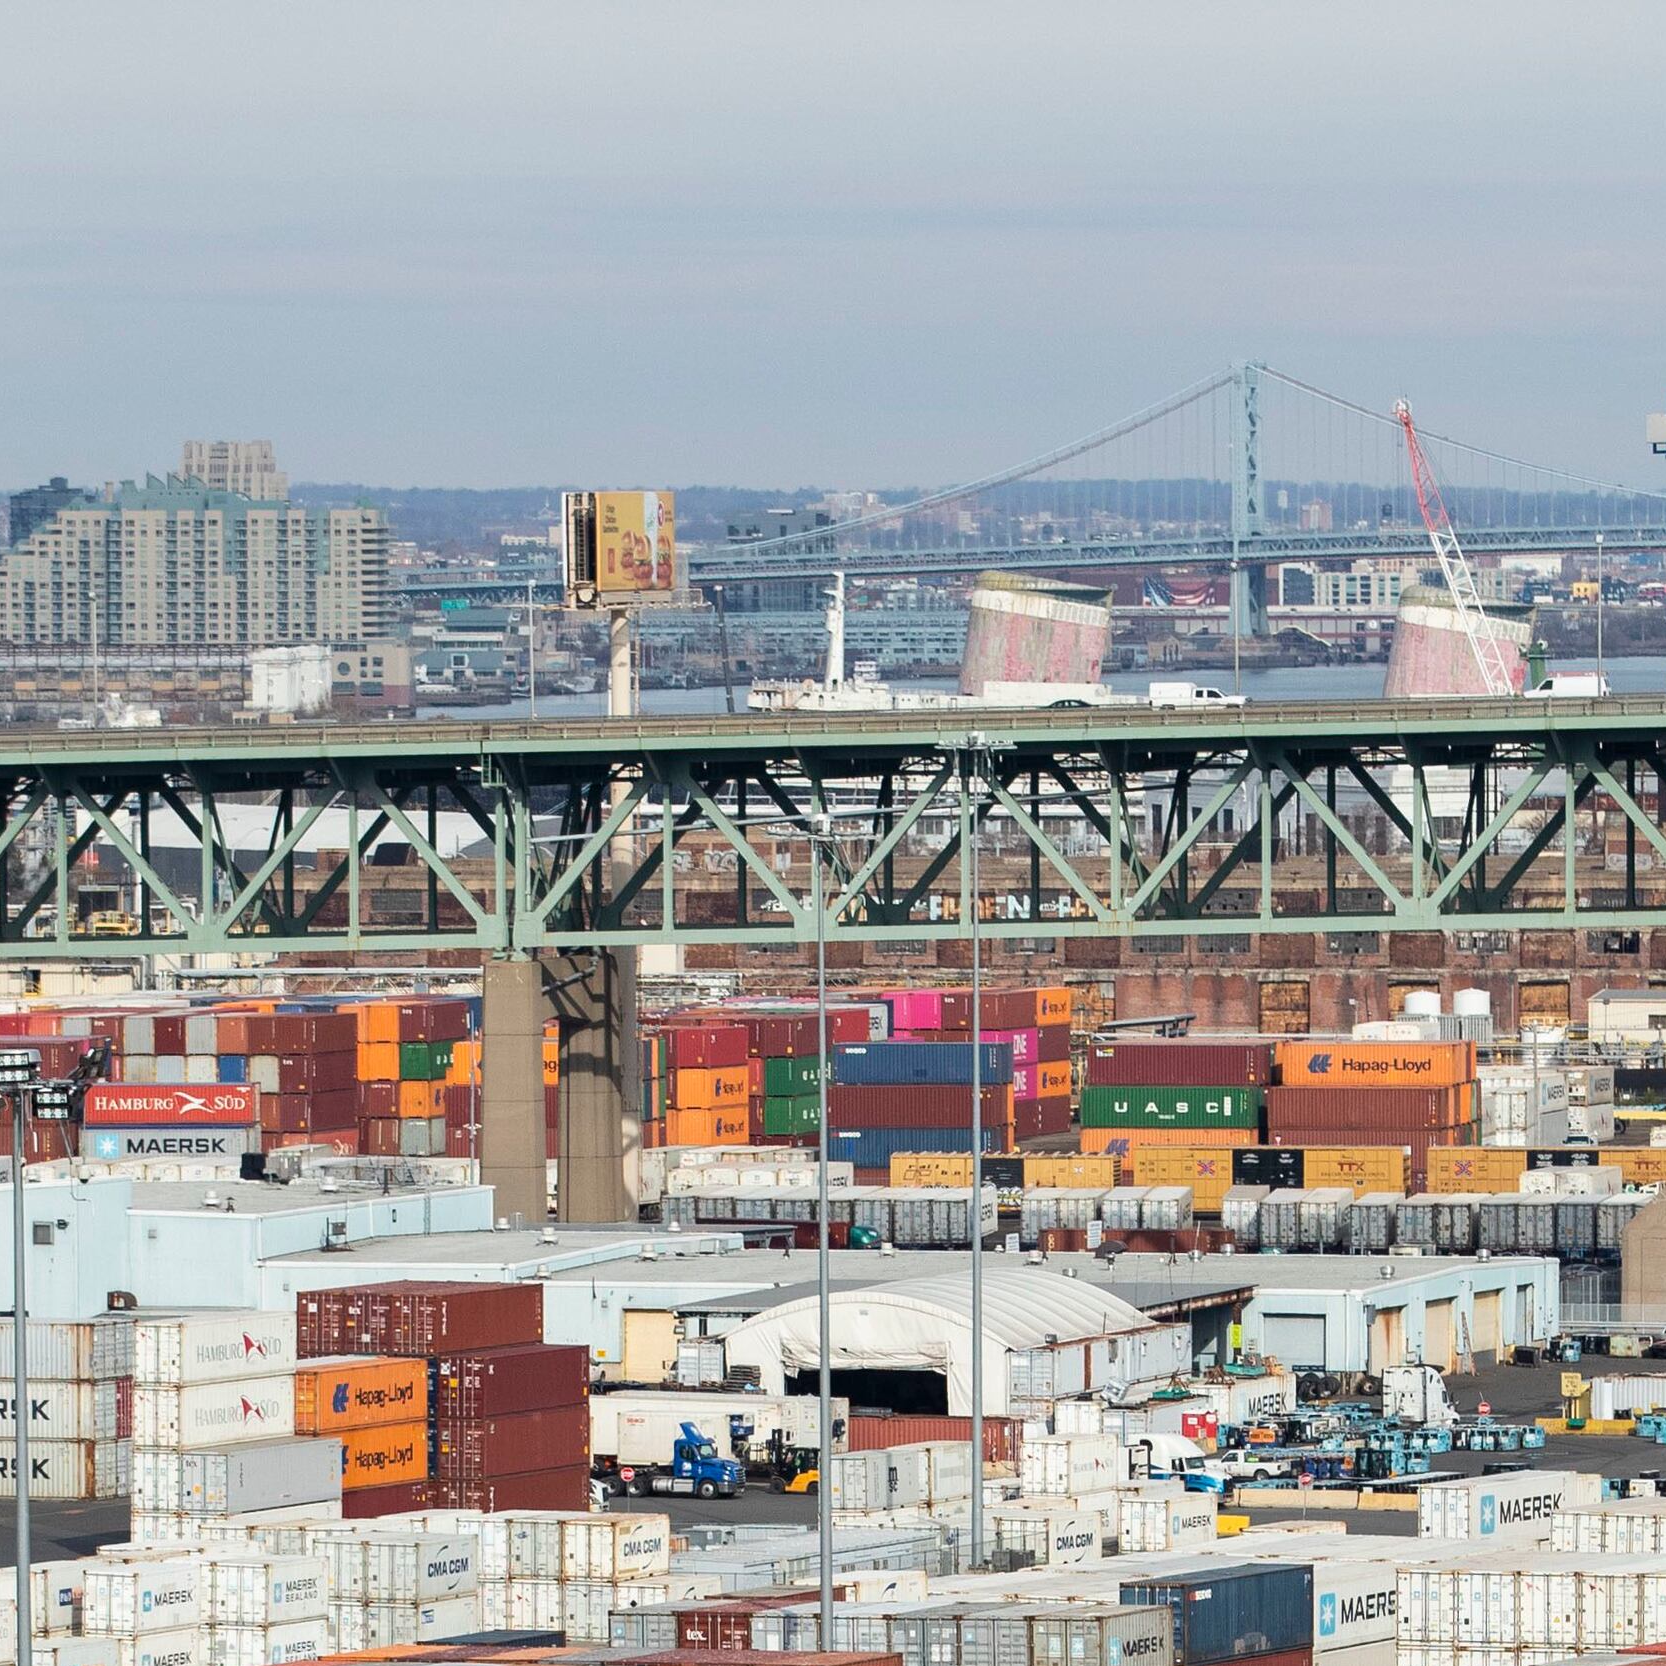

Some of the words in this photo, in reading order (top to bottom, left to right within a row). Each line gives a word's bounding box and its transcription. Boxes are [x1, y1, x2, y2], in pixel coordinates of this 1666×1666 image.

[1341, 1058, 1431, 1077] Hapag-Lloyd
[95, 1095, 173, 1111] HAMBURG
[214, 1095, 245, 1110] SÜD
[1114, 1099, 1219, 1115] UASC
[127, 1138, 225, 1154] MAERSK
[196, 1343, 244, 1364] HAMBURG
[354, 1382, 413, 1406] Hapag-Lloyd
[1248, 1394, 1287, 1414] MAERSK
[195, 1403, 244, 1424] HAMBURG
[354, 1446, 413, 1470] Hapag-Lloyd
[1500, 1492, 1562, 1524] MAERSK
[1182, 1515, 1211, 1529] MAERSK
[1057, 1534, 1074, 1551] CMA
[1075, 1531, 1094, 1549] CGM
[428, 1561, 449, 1578] CMA
[451, 1557, 469, 1575] CGM
[285, 1579, 317, 1592] MAERSK
[155, 1589, 194, 1606] MAERSK
[1122, 1636, 1164, 1659] MAERSK
